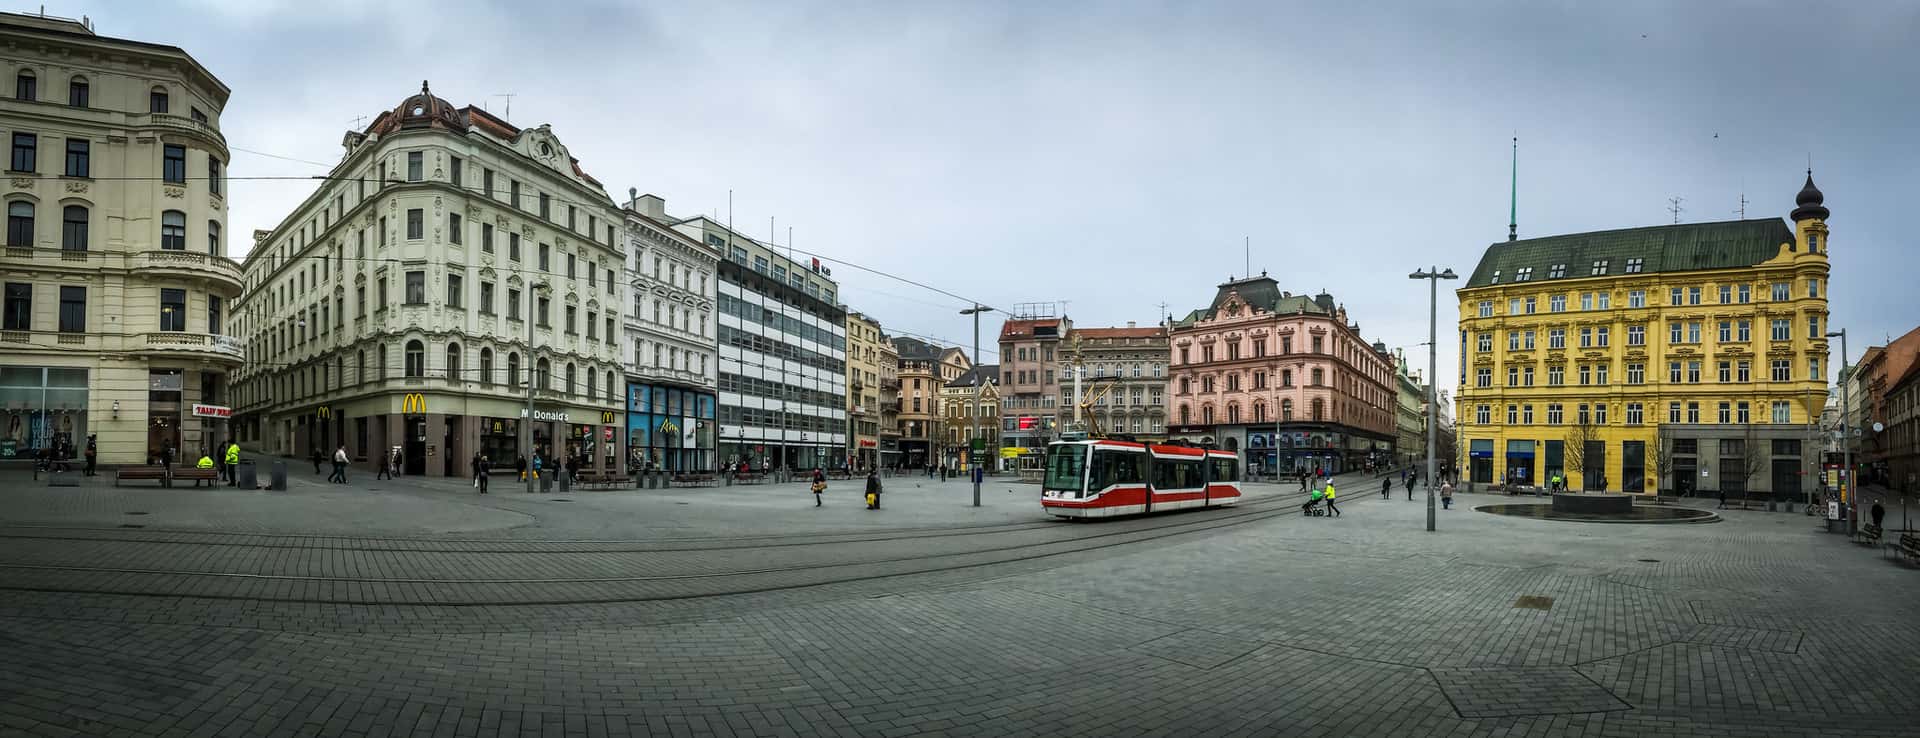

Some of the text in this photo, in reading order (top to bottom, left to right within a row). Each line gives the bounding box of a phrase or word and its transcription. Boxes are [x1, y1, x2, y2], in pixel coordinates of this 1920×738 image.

[821, 264, 831, 276] KB
[521, 408, 569, 421] MDonald's
[32, 429, 55, 439] YOUR
